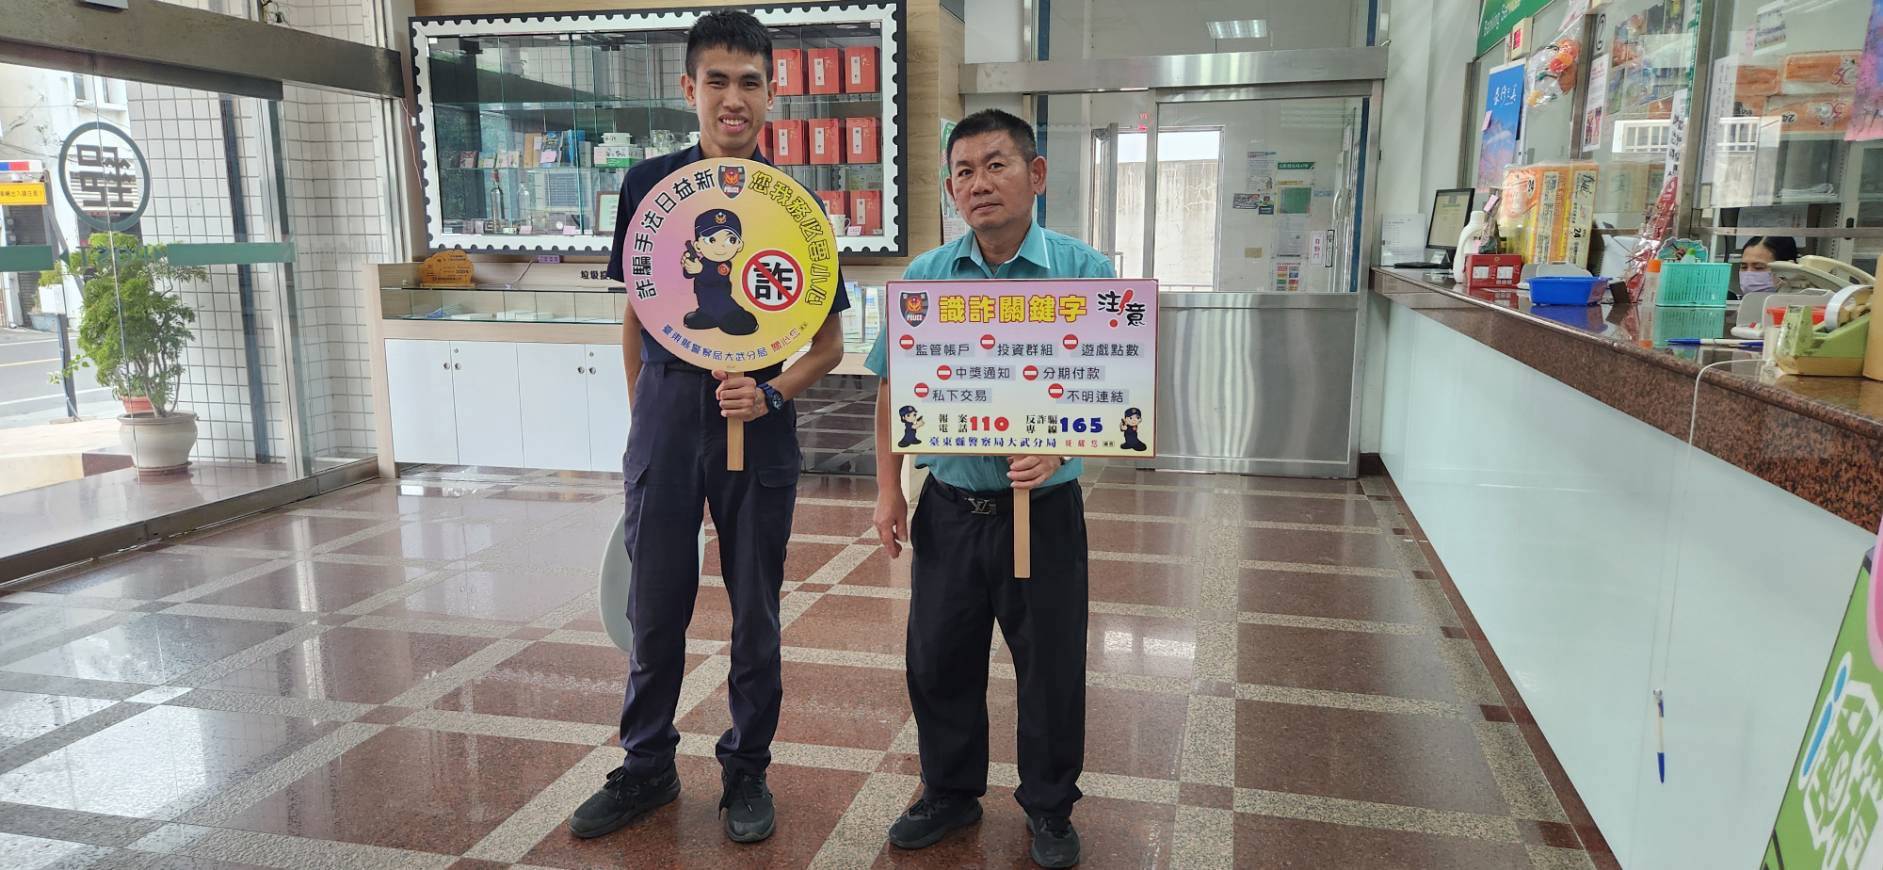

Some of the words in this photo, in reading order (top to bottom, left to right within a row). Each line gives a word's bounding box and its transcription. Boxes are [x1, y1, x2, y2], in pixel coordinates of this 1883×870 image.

[632, 168, 715, 300] 詐騙手法日益新
[749, 170, 831, 306] 您我務必要小心
[753, 261, 794, 300] 詐
[938, 294, 1088, 324] 識詐關鍵字
[915, 343, 970, 357] 監管帳戶
[997, 343, 1054, 357] 投資群組
[1080, 343, 1140, 357] 遊戲點數
[955, 366, 1011, 380] 中獎通知
[1042, 366, 1101, 380] 分期付款
[932, 389, 988, 402] 私下交易
[1066, 389, 1124, 403] 不明連結
[969, 416, 1010, 432] 110
[1026, 414, 1058, 424] 反詐騙
[1059, 416, 1104, 433] 165
[929, 436, 1057, 448] 臺東縣警察局大武分局
